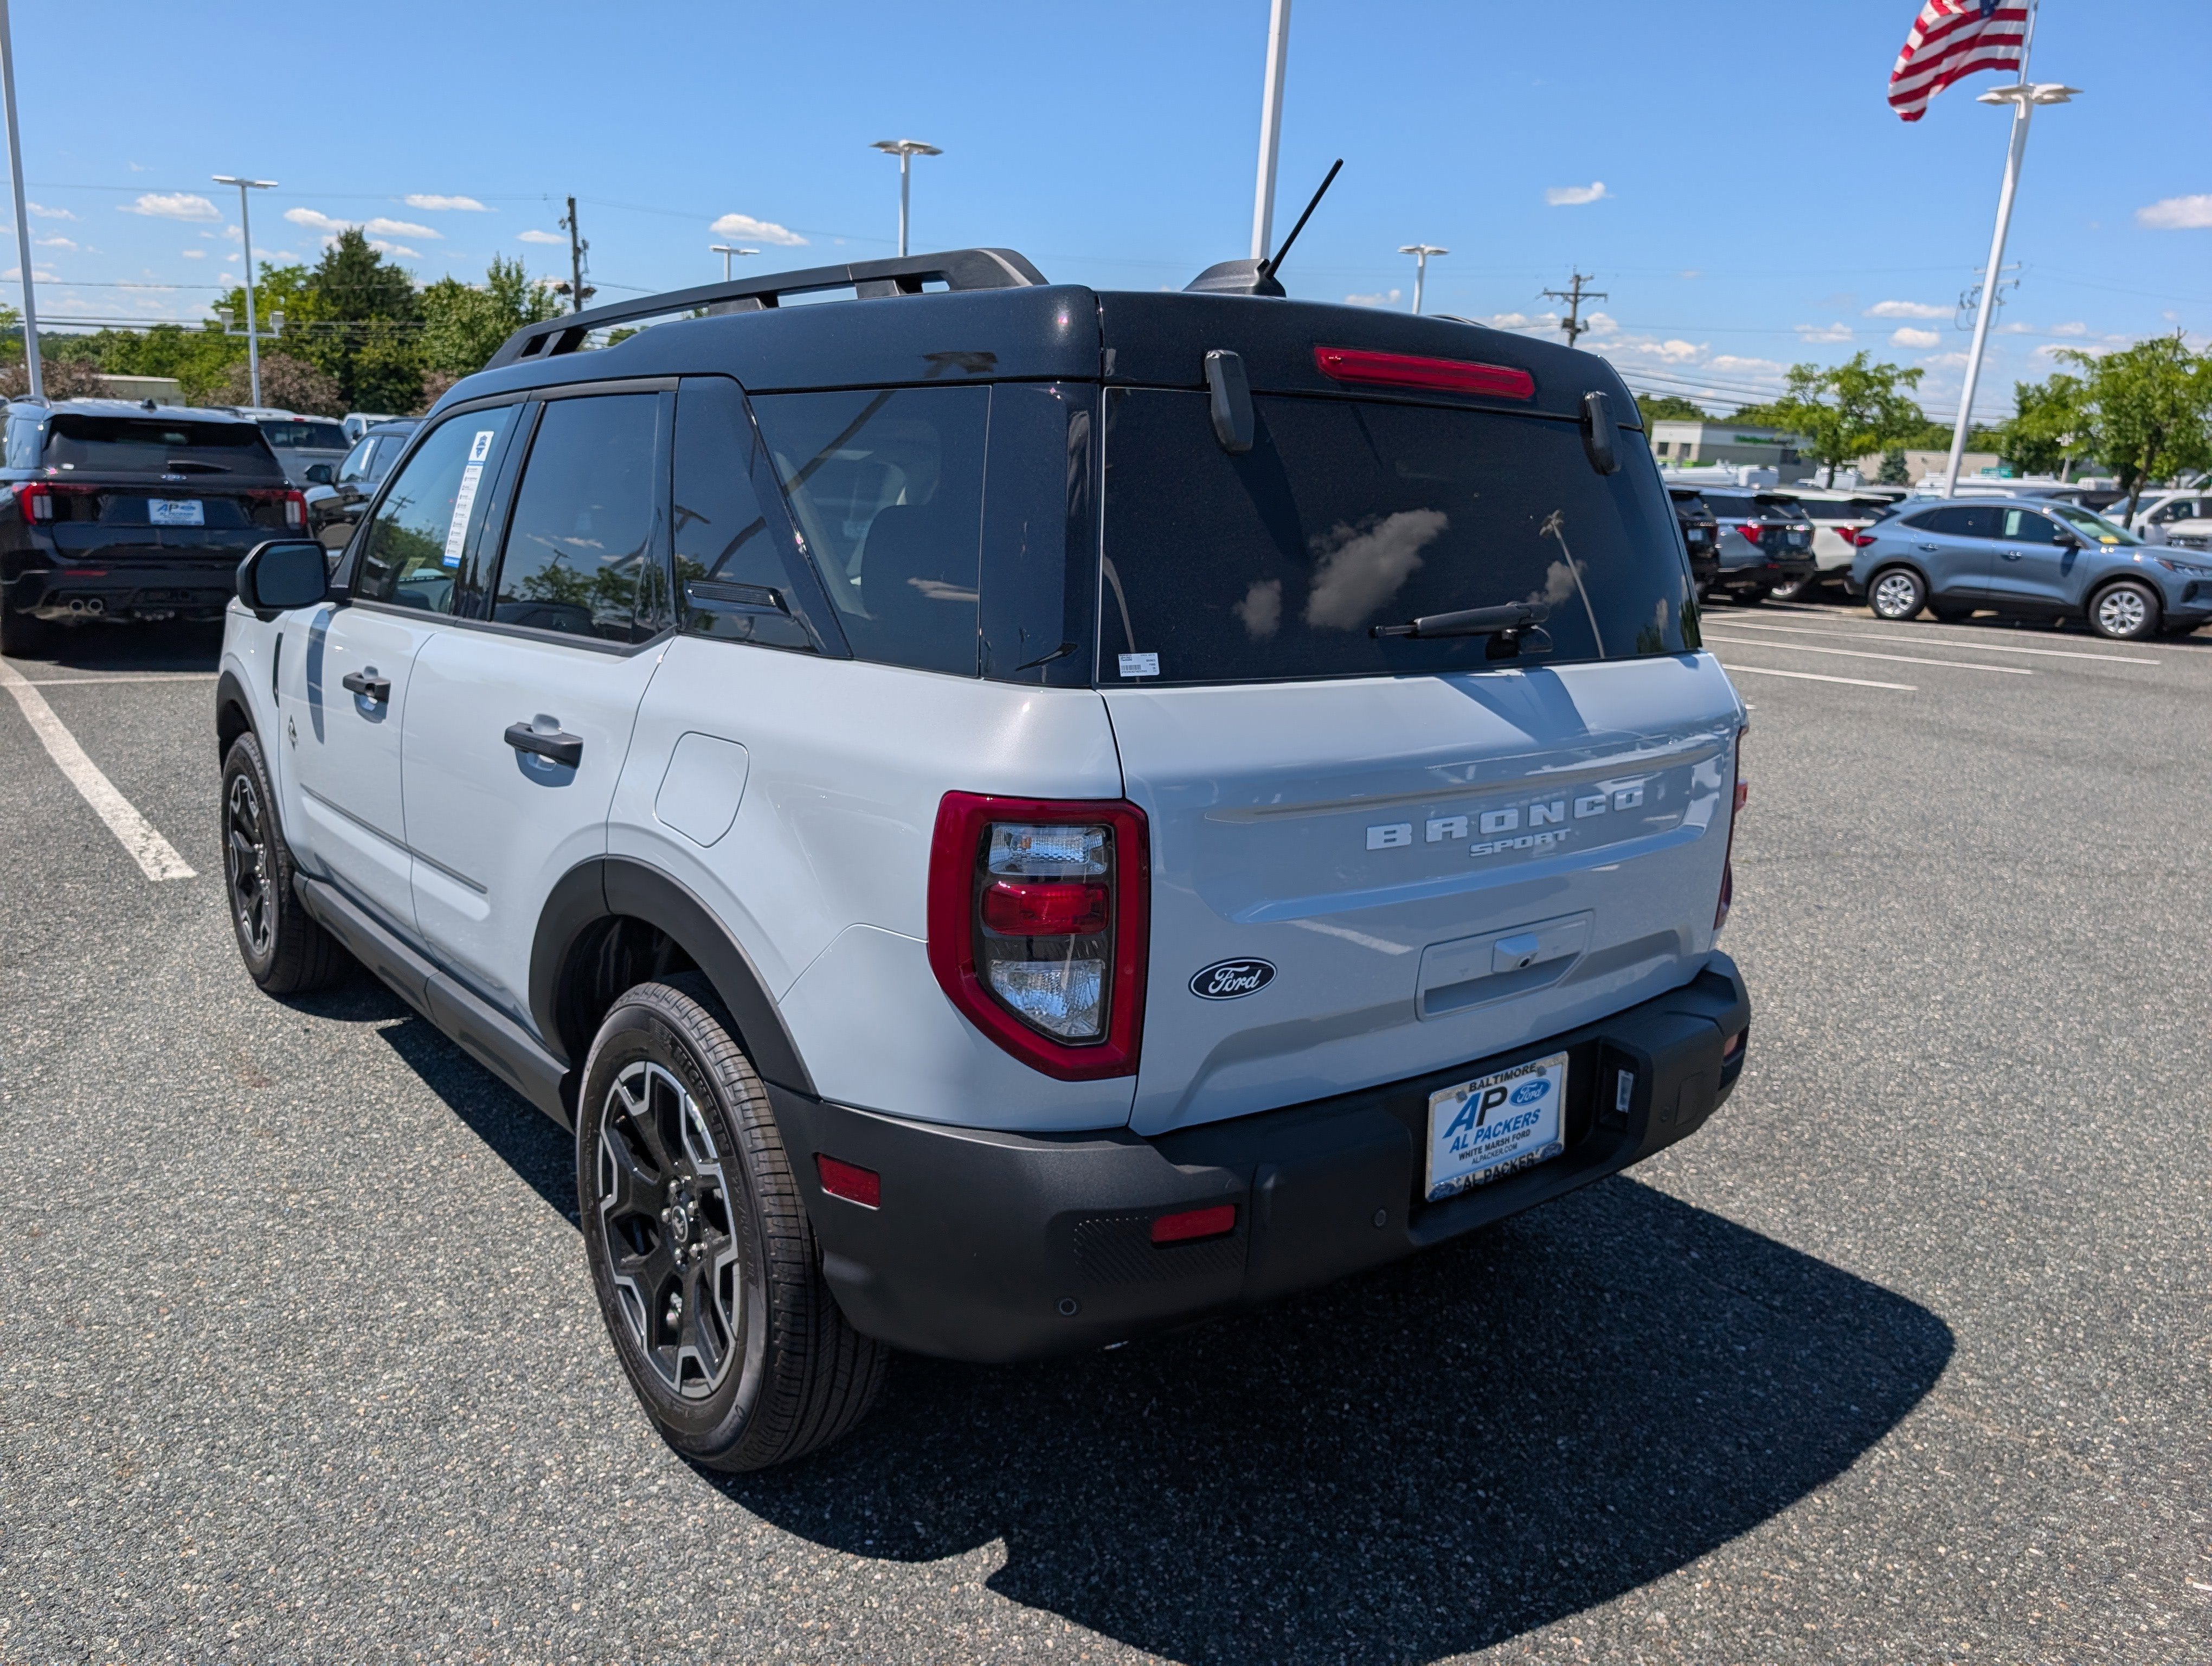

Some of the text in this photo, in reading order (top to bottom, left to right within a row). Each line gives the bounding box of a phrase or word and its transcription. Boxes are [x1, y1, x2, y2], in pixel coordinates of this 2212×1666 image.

[1366, 787, 1643, 850] BRONCO
[1470, 828, 1571, 857] SPORT
[1208, 965, 1262, 994] Ford
[1469, 1062, 1536, 1092] BALTIMORE
[1516, 1080, 1544, 1103] Ford
[673, 1046, 730, 1151] MICHELIN
[1442, 1086, 1508, 1138] AP
[1449, 1108, 1541, 1154] AL PACKERS
[1459, 1129, 1531, 1161] WHITE MARSH FORD
[1471, 1143, 1517, 1164] ALPACKER.COM
[1463, 1173, 1483, 1190] AL
